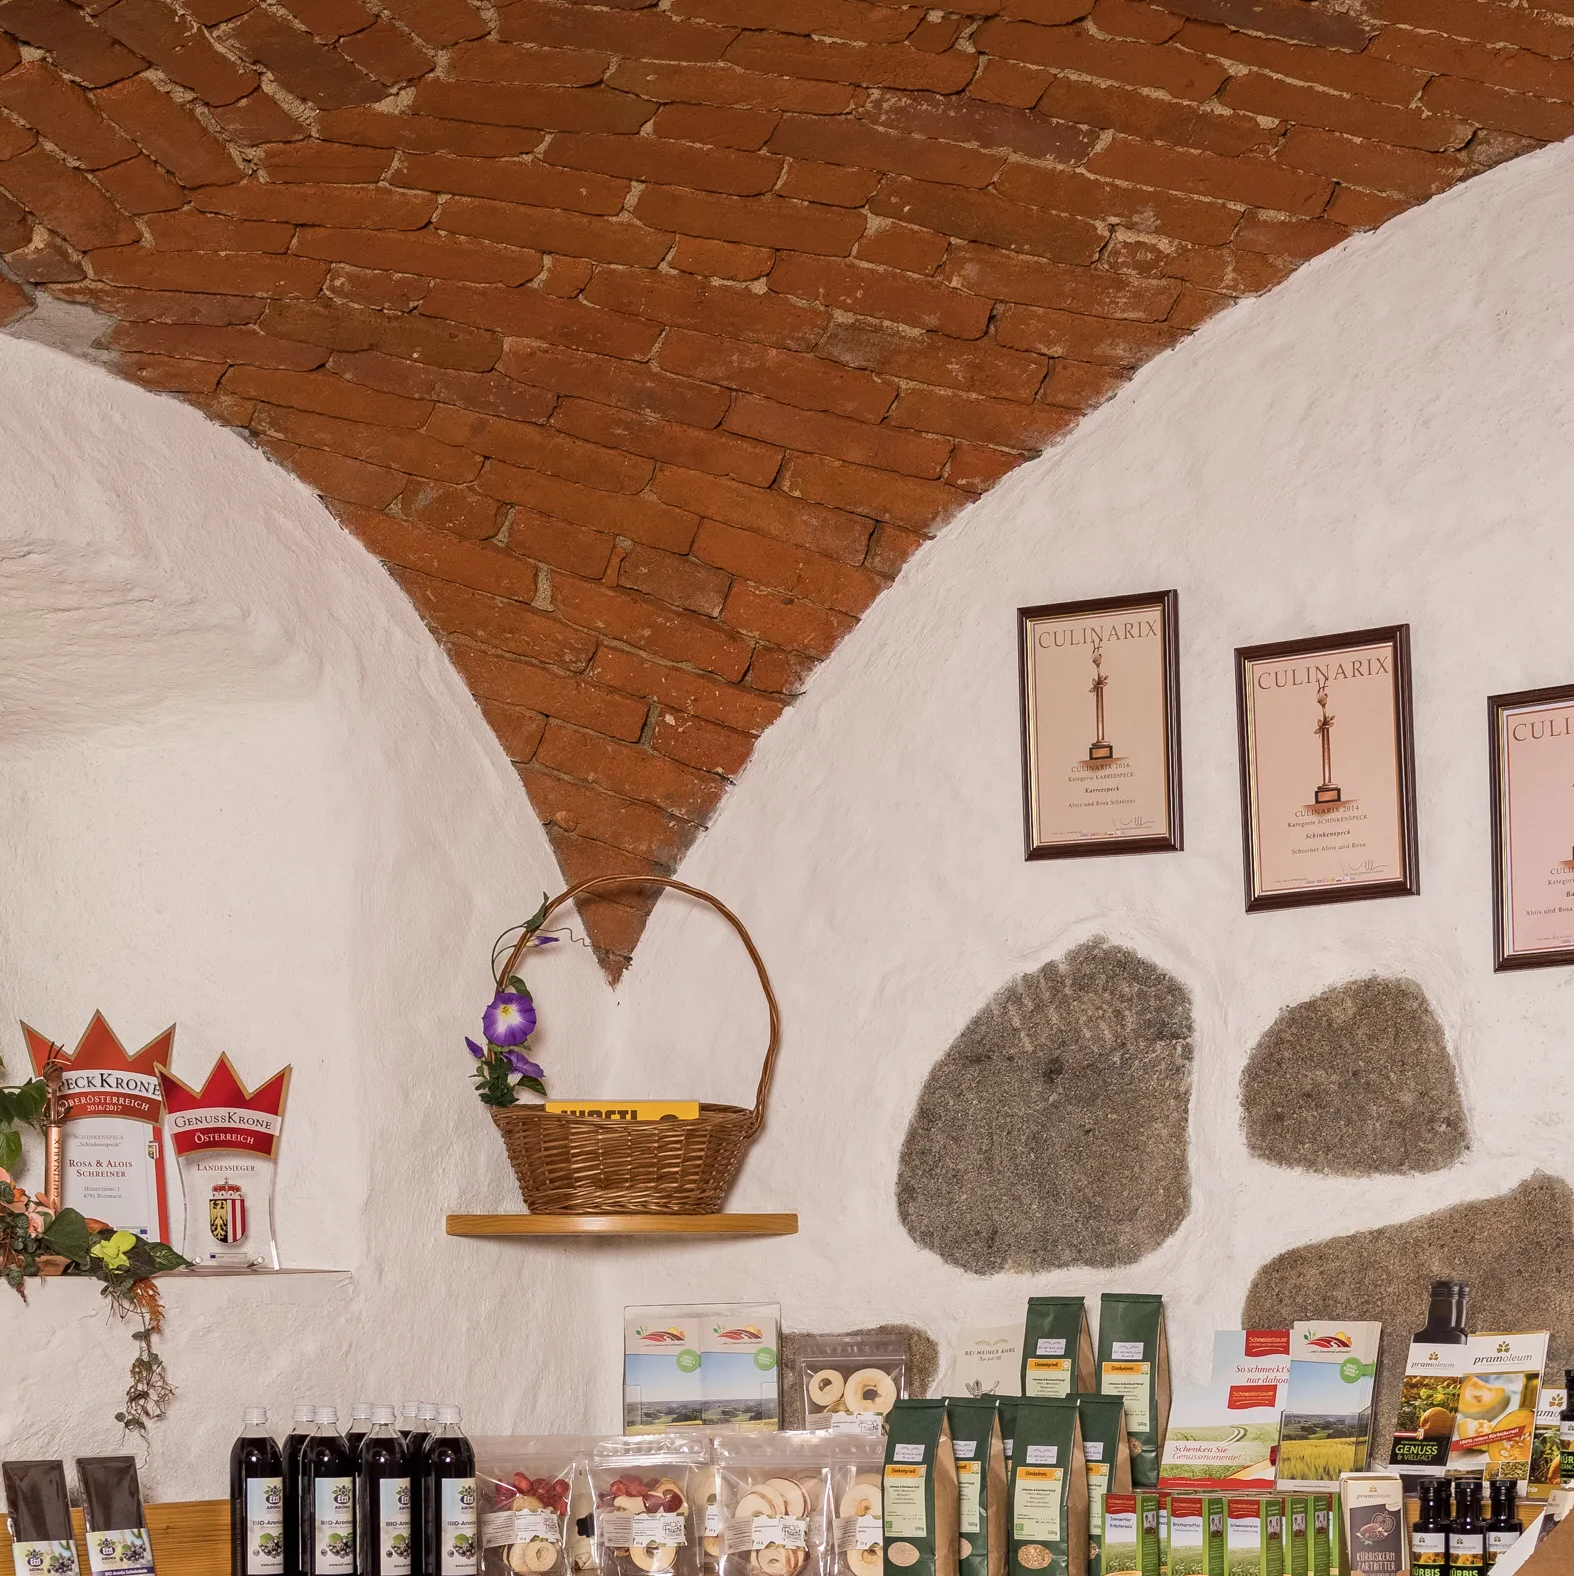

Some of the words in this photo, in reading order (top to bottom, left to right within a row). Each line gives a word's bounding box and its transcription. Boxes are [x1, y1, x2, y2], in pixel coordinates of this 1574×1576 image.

[1038, 619, 1158, 649] CULINARIX
[1257, 656, 1389, 690] CULINARIX
[1071, 763, 1113, 773] CULINARIX
[1114, 762, 1130, 771] 2016
[1085, 785, 1120, 794] Karreespeck
[1294, 807, 1341, 818] CULINARIX
[1342, 804, 1360, 813] 2014
[1305, 829, 1351, 840] Schinkenspeck
[86, 1104, 122, 1112] 2016/2017
[194, 1131, 255, 1145] ÖSTERREICH
[68, 1159, 94, 1168] ROSA
[95, 1159, 103, 1168] &
[105, 1159, 133, 1168] ALOIS
[196, 1163, 256, 1172] LANDESSIEGER
[76, 1169, 127, 1178] SCHREINER
[1472, 1354, 1533, 1366] pramoleum
[1235, 1365, 1246, 1373] So
[1411, 1361, 1455, 1369] pramoleum
[1262, 1375, 1289, 1384] dahoa
[1173, 1445, 1213, 1453] Schenken
[1395, 1445, 1438, 1455] GENUSS
[1172, 1453, 1242, 1461] Genussmomente!
[1356, 1551, 1396, 1561] KÜRBISKERN
[1357, 1562, 1396, 1571] ZARTBITTER
[1413, 1567, 1440, 1576] ÜRBIS
